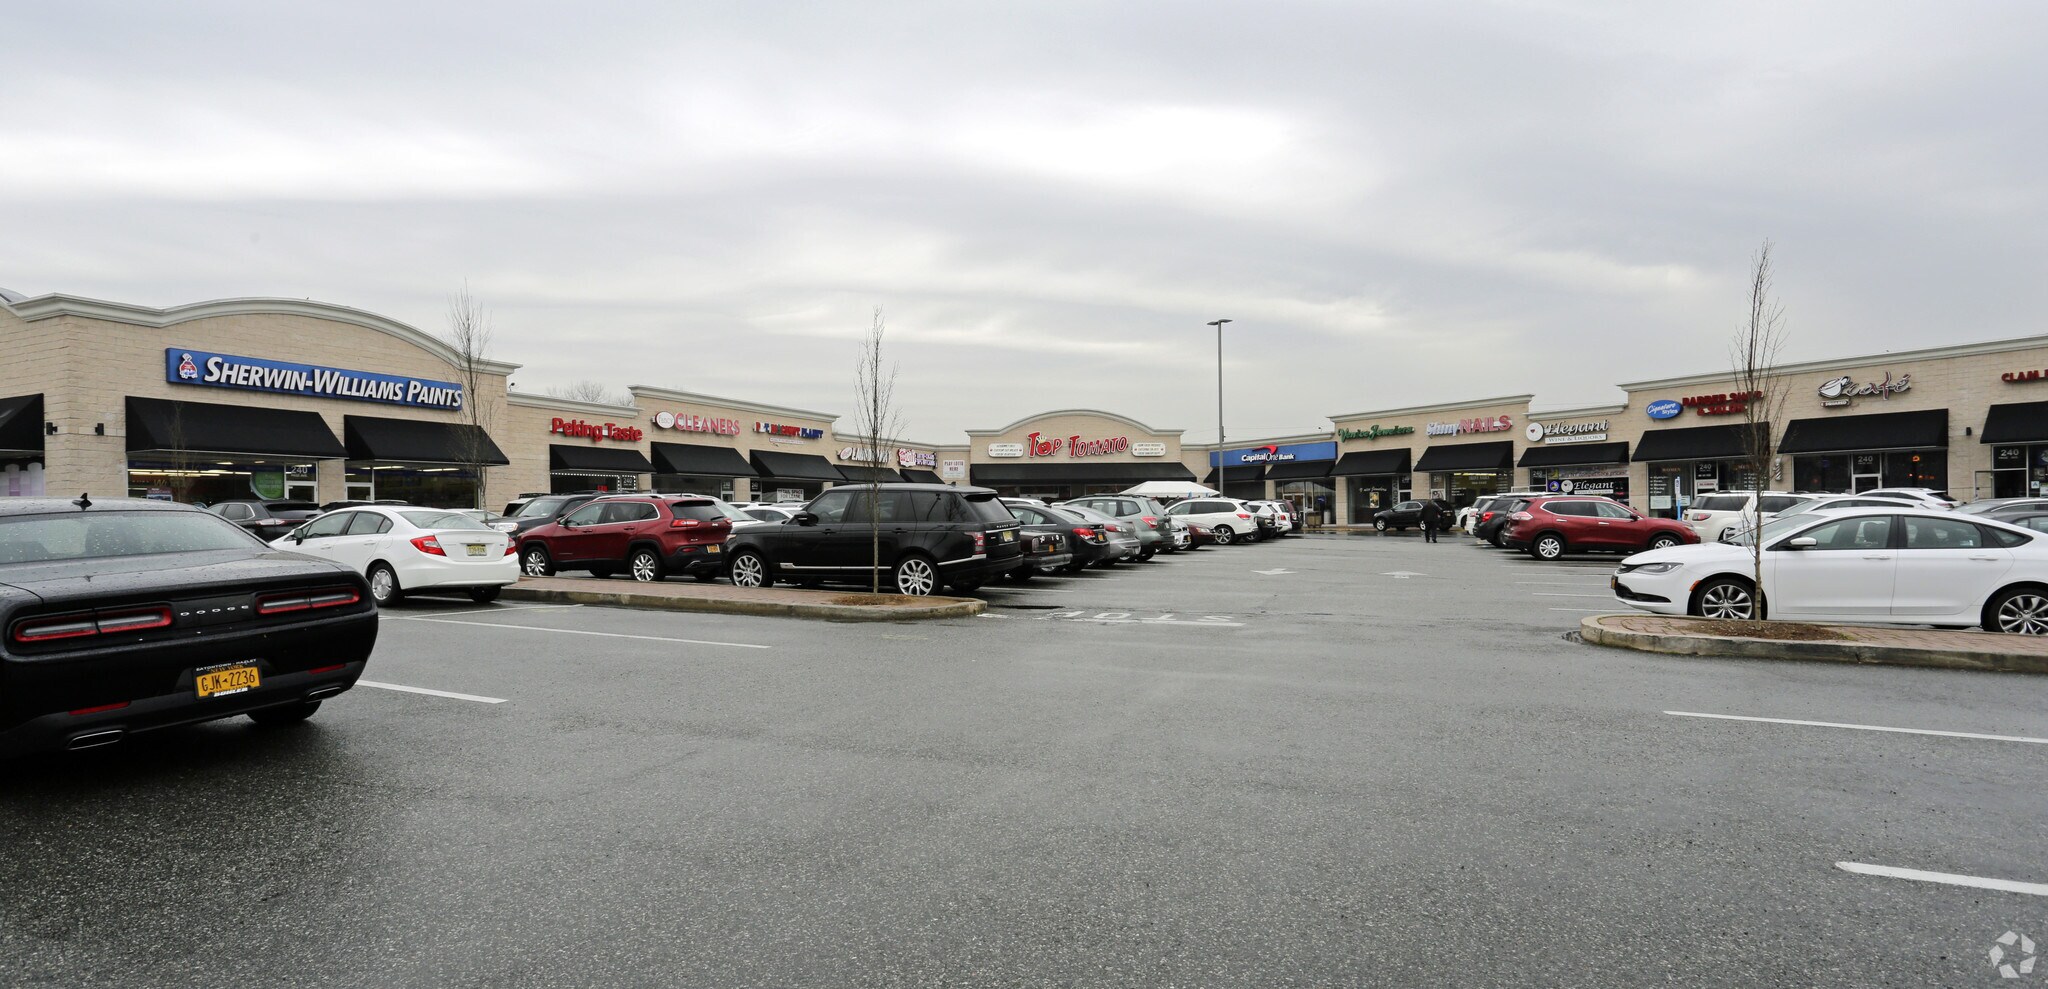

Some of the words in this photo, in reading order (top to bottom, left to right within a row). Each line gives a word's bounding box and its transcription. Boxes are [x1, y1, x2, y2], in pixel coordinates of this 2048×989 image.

[204, 357, 403, 401] SHERWIN-WILLIAMS
[406, 380, 462, 407] PAINTS
[2001, 370, 2039, 382] CLAM
[1682, 394, 1727, 406] BARBER
[551, 417, 603, 442] Peking
[604, 422, 643, 441] Taste
[675, 412, 741, 436] CLEANERS
[1426, 422, 1460, 436] Shiny
[1460, 415, 1512, 433] NAILS
[1544, 420, 1609, 436] Elegant
[1068, 435, 1128, 457] TOMATO
[2001, 449, 2020, 457] 240
[290, 466, 308, 474] 240
[1574, 480, 1614, 490] Elegant
[180, 605, 249, 616] DODGE
